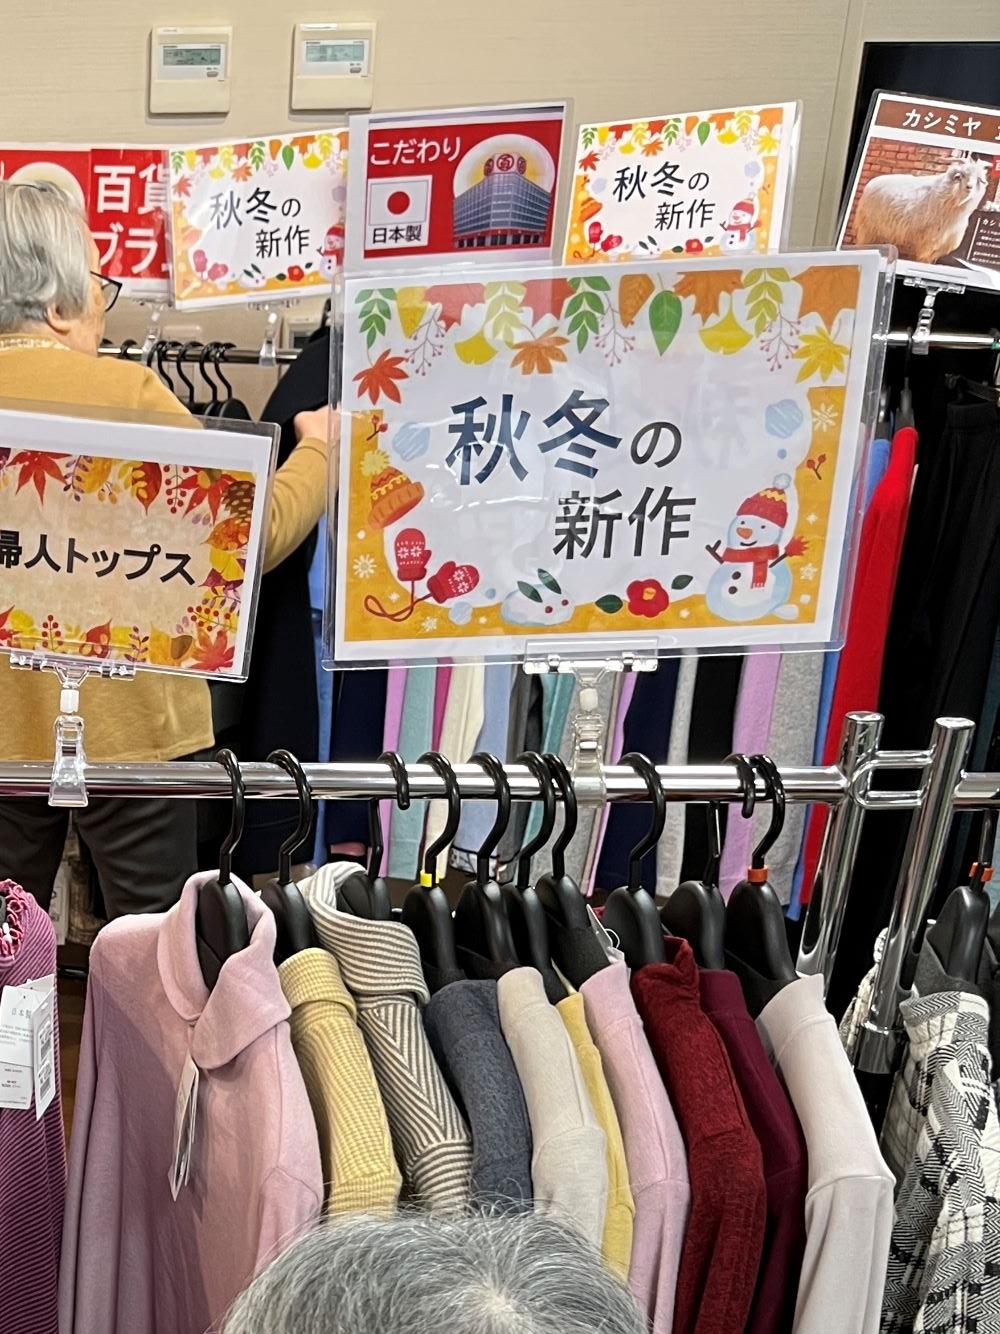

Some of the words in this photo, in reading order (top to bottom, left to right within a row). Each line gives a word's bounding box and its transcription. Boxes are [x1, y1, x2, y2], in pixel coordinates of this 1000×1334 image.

[902, 108, 982, 137] カシミヤ
[370, 137, 461, 166] こだわり
[612, 161, 710, 203] 秋冬の
[210, 187, 301, 230] 秋冬の
[654, 198, 716, 231] 新作
[256, 224, 310, 259] 新作
[373, 225, 422, 245] 日本製
[445, 389, 682, 486] 秋冬の
[553, 486, 697, 560] 新作
